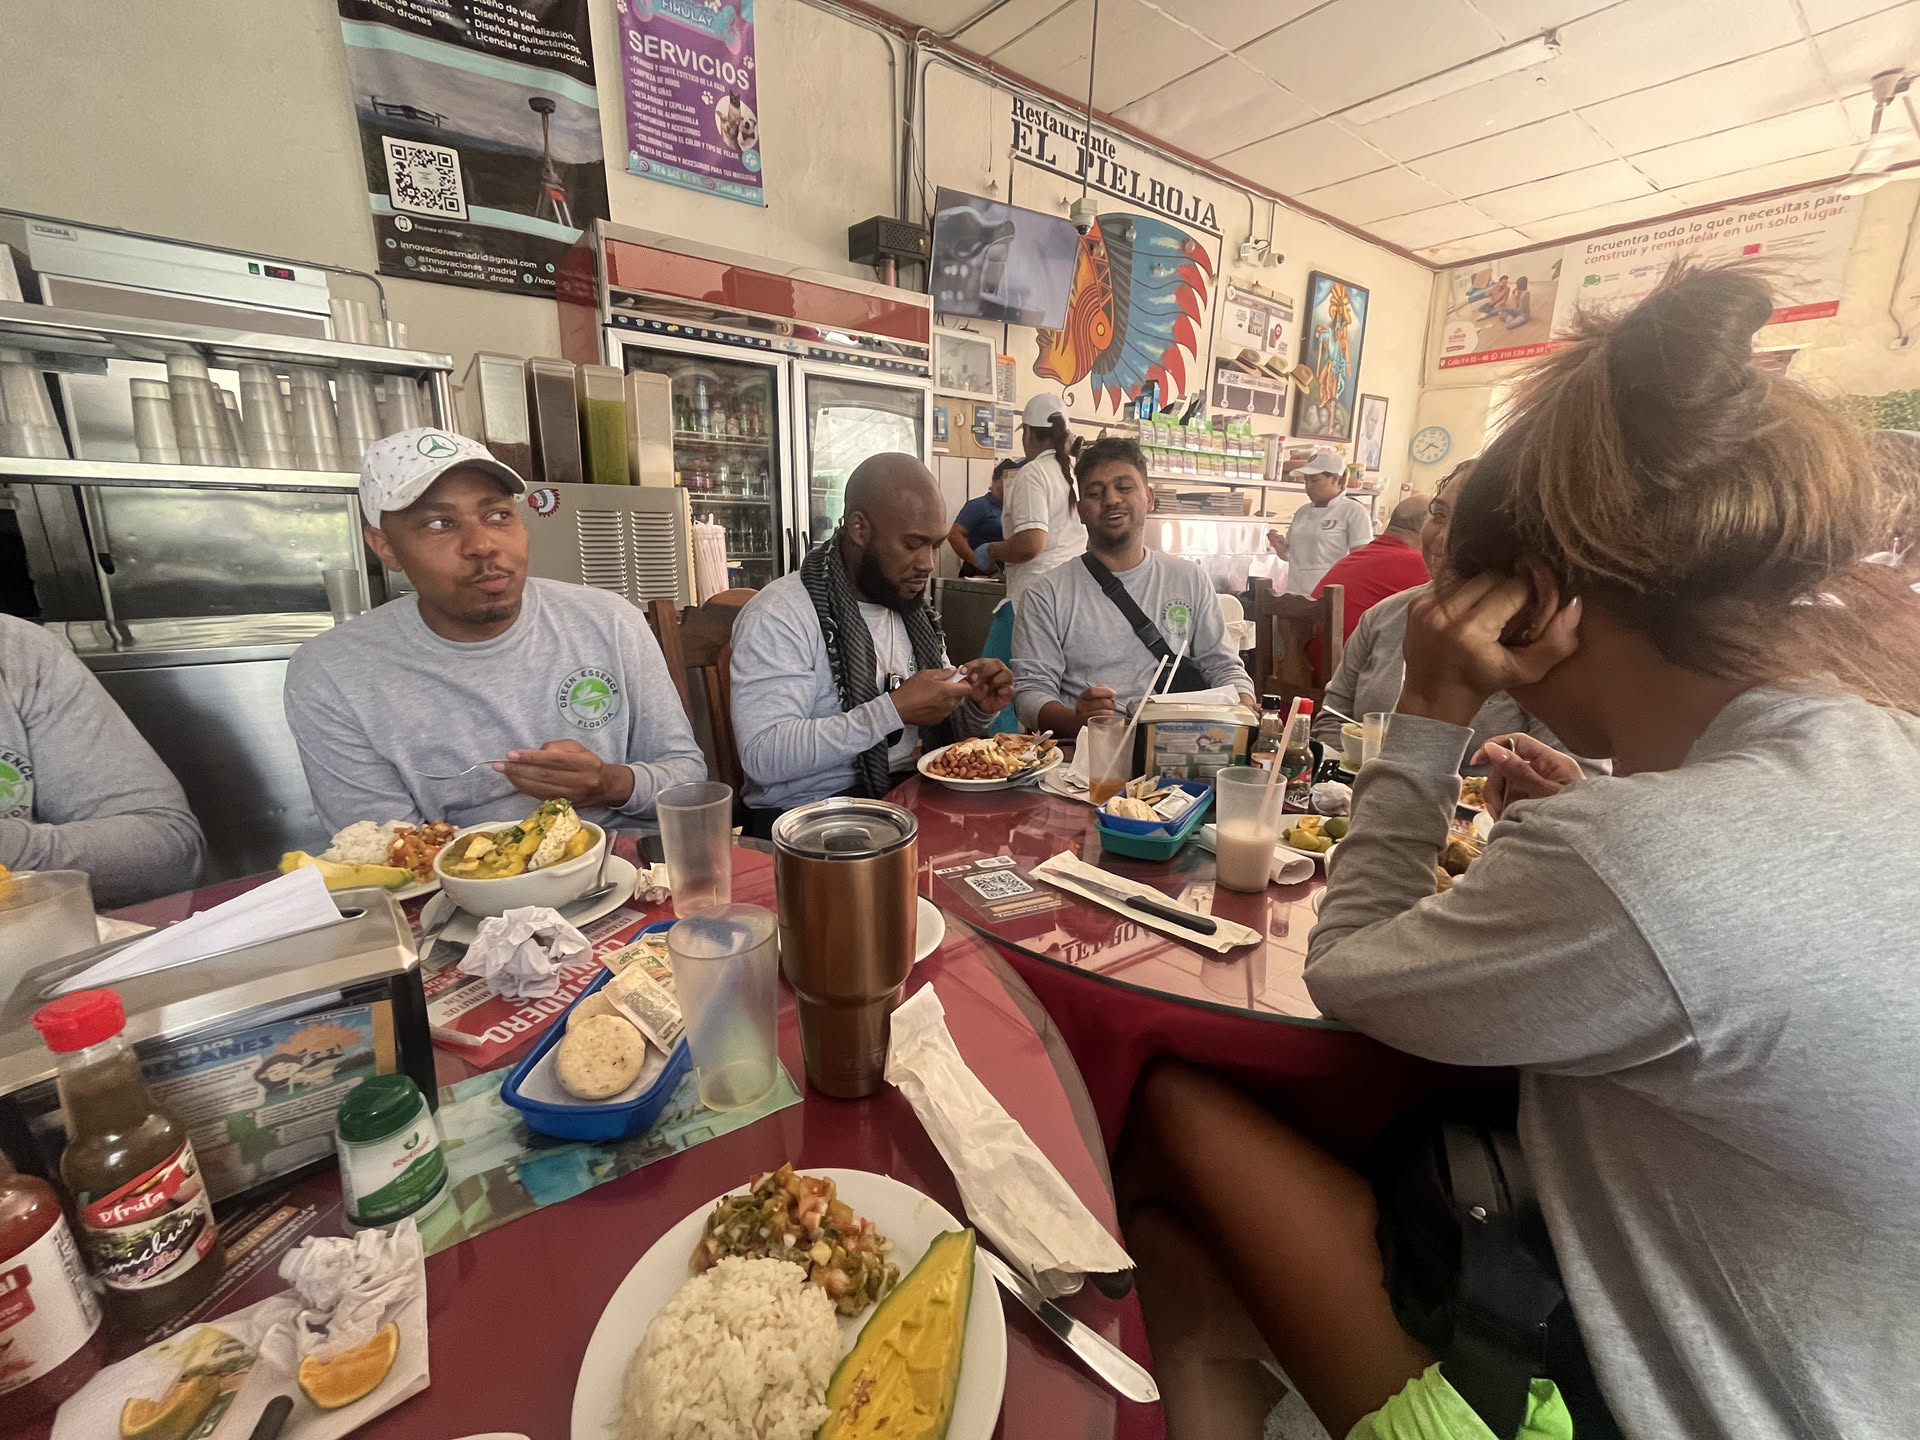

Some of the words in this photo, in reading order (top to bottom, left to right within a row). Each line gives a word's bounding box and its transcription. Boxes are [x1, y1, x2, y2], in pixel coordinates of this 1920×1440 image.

[397, 8, 432, 26] drones
[410, 2, 453, 20] equipos.
[473, 6, 506, 24] Diseño
[507, 18, 519, 29] de
[520, 22, 576, 41] señalización.
[505, 4, 518, 15] de
[662, 0, 713, 26] FIRULAY
[475, 19, 511, 37] Diseños
[512, 31, 582, 55] arquitectónicos.
[475, 31, 518, 51] Licencias
[519, 45, 532, 54] de
[533, 48, 590, 68] construcción.
[628, 29, 751, 91] SERVICIOS
[1011, 95, 1117, 159] Restaurante
[1011, 118, 1057, 166] EL
[1075, 145, 1221, 232] PIELROJA
[1584, 247, 1638, 265] construir
[1640, 246, 1648, 257] y
[1652, 231, 1720, 251] remodelar
[1723, 227, 1740, 238] en
[1745, 221, 1763, 233] un
[1768, 214, 1799, 229] solo
[1586, 234, 1650, 254] Encuentra
[1653, 226, 1685, 241] todo
[1689, 222, 1702, 233] lo
[1706, 217, 1734, 231] que
[1738, 199, 1810, 223] necesitas
[1813, 194, 1851, 210] para
[400, 240, 538, 270] Innovacionesmadrid@gmail.com
[560, 675, 577, 708] GREEN
[581, 669, 619, 695] ESSENCE
[577, 711, 614, 728] FLORIDA
